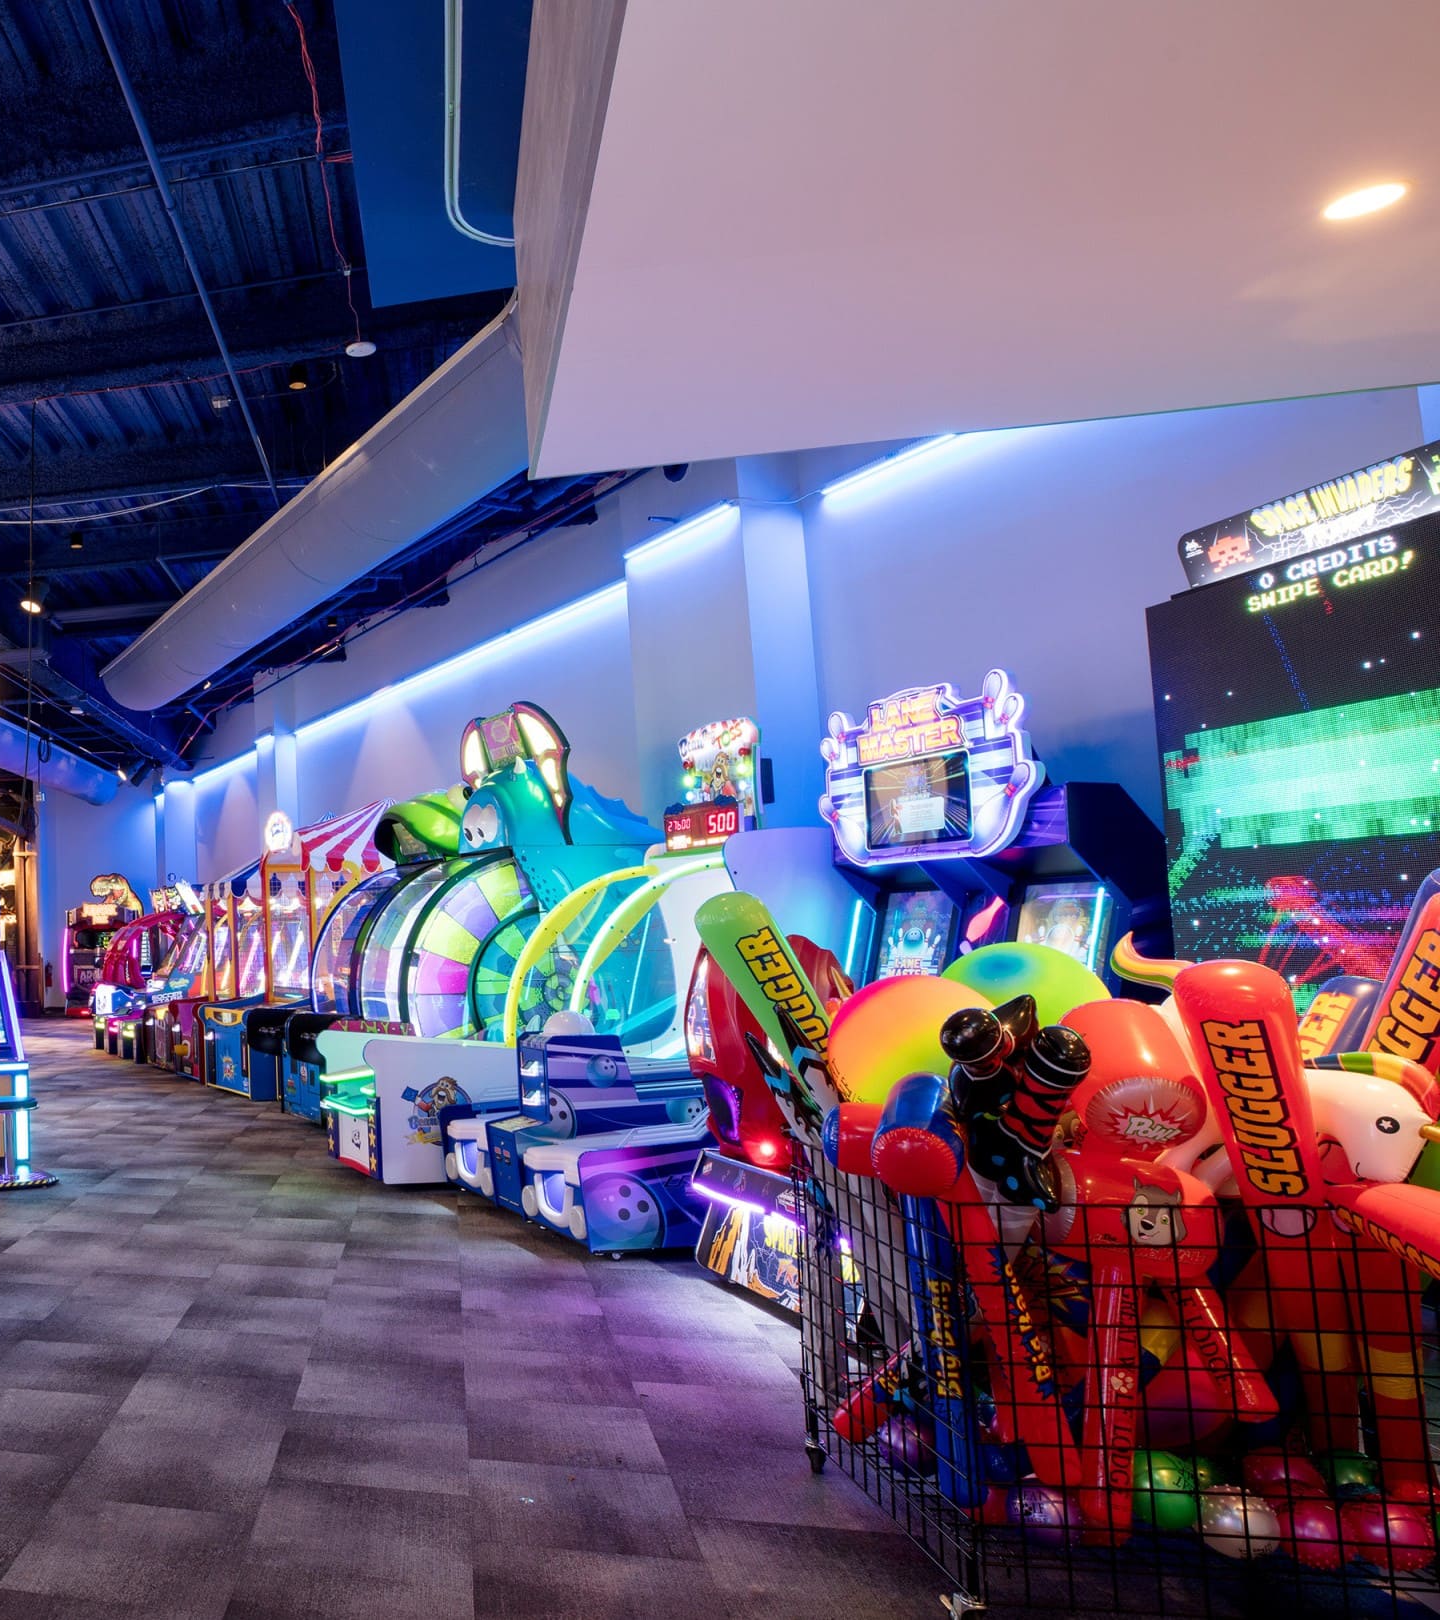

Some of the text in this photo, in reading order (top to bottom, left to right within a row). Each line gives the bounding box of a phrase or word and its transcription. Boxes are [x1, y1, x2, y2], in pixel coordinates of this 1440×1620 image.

[1250, 490, 1317, 537] SPACE
[1310, 455, 1413, 519] INVADERS
[1287, 534, 1397, 580] CREDITS
[1247, 550, 1415, 613] SWIPE CARD!
[870, 690, 939, 733] LANE
[860, 718, 962, 763] MASTER
[708, 811, 736, 835] 500
[1199, 1018, 1310, 1198] SLUGGER
